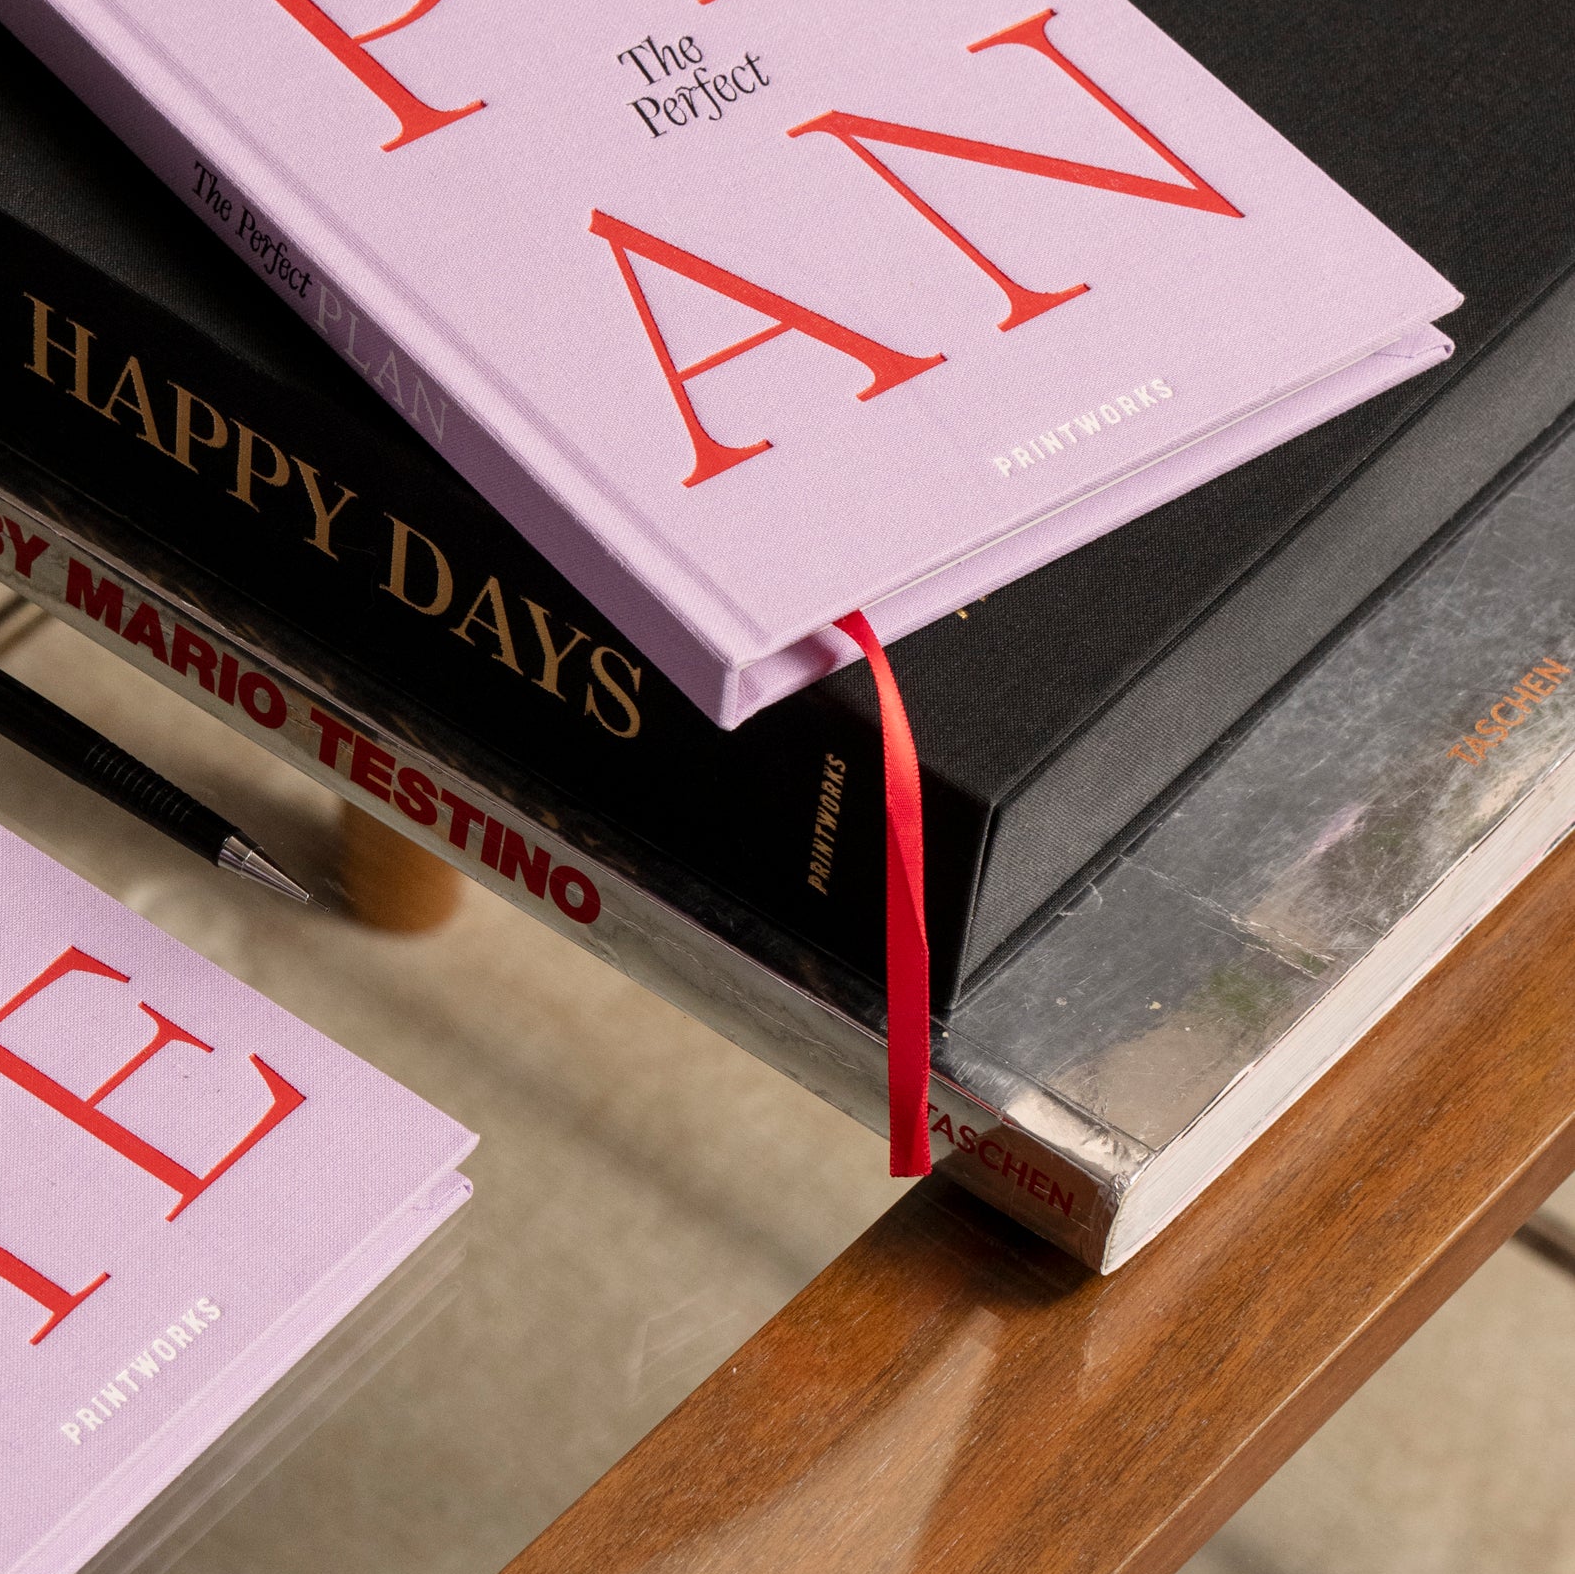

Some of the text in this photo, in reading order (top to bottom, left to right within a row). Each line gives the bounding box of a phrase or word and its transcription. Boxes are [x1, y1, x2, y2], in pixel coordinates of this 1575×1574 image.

[616, 35, 703, 86] The
[625, 51, 770, 139] Perfect
[192, 160, 451, 445] The Perfect PLAN
[993, 377, 1174, 478] PRINTWORKS
[22, 291, 641, 739] HAPPY DAYS
[64, 556, 289, 731] MARIO
[310, 708, 602, 925] TESTINO
[1445, 656, 1573, 767] TASCHEN
[807, 752, 847, 896] PRINTWORKS
[60, 1296, 222, 1446] PRINTWORKS
